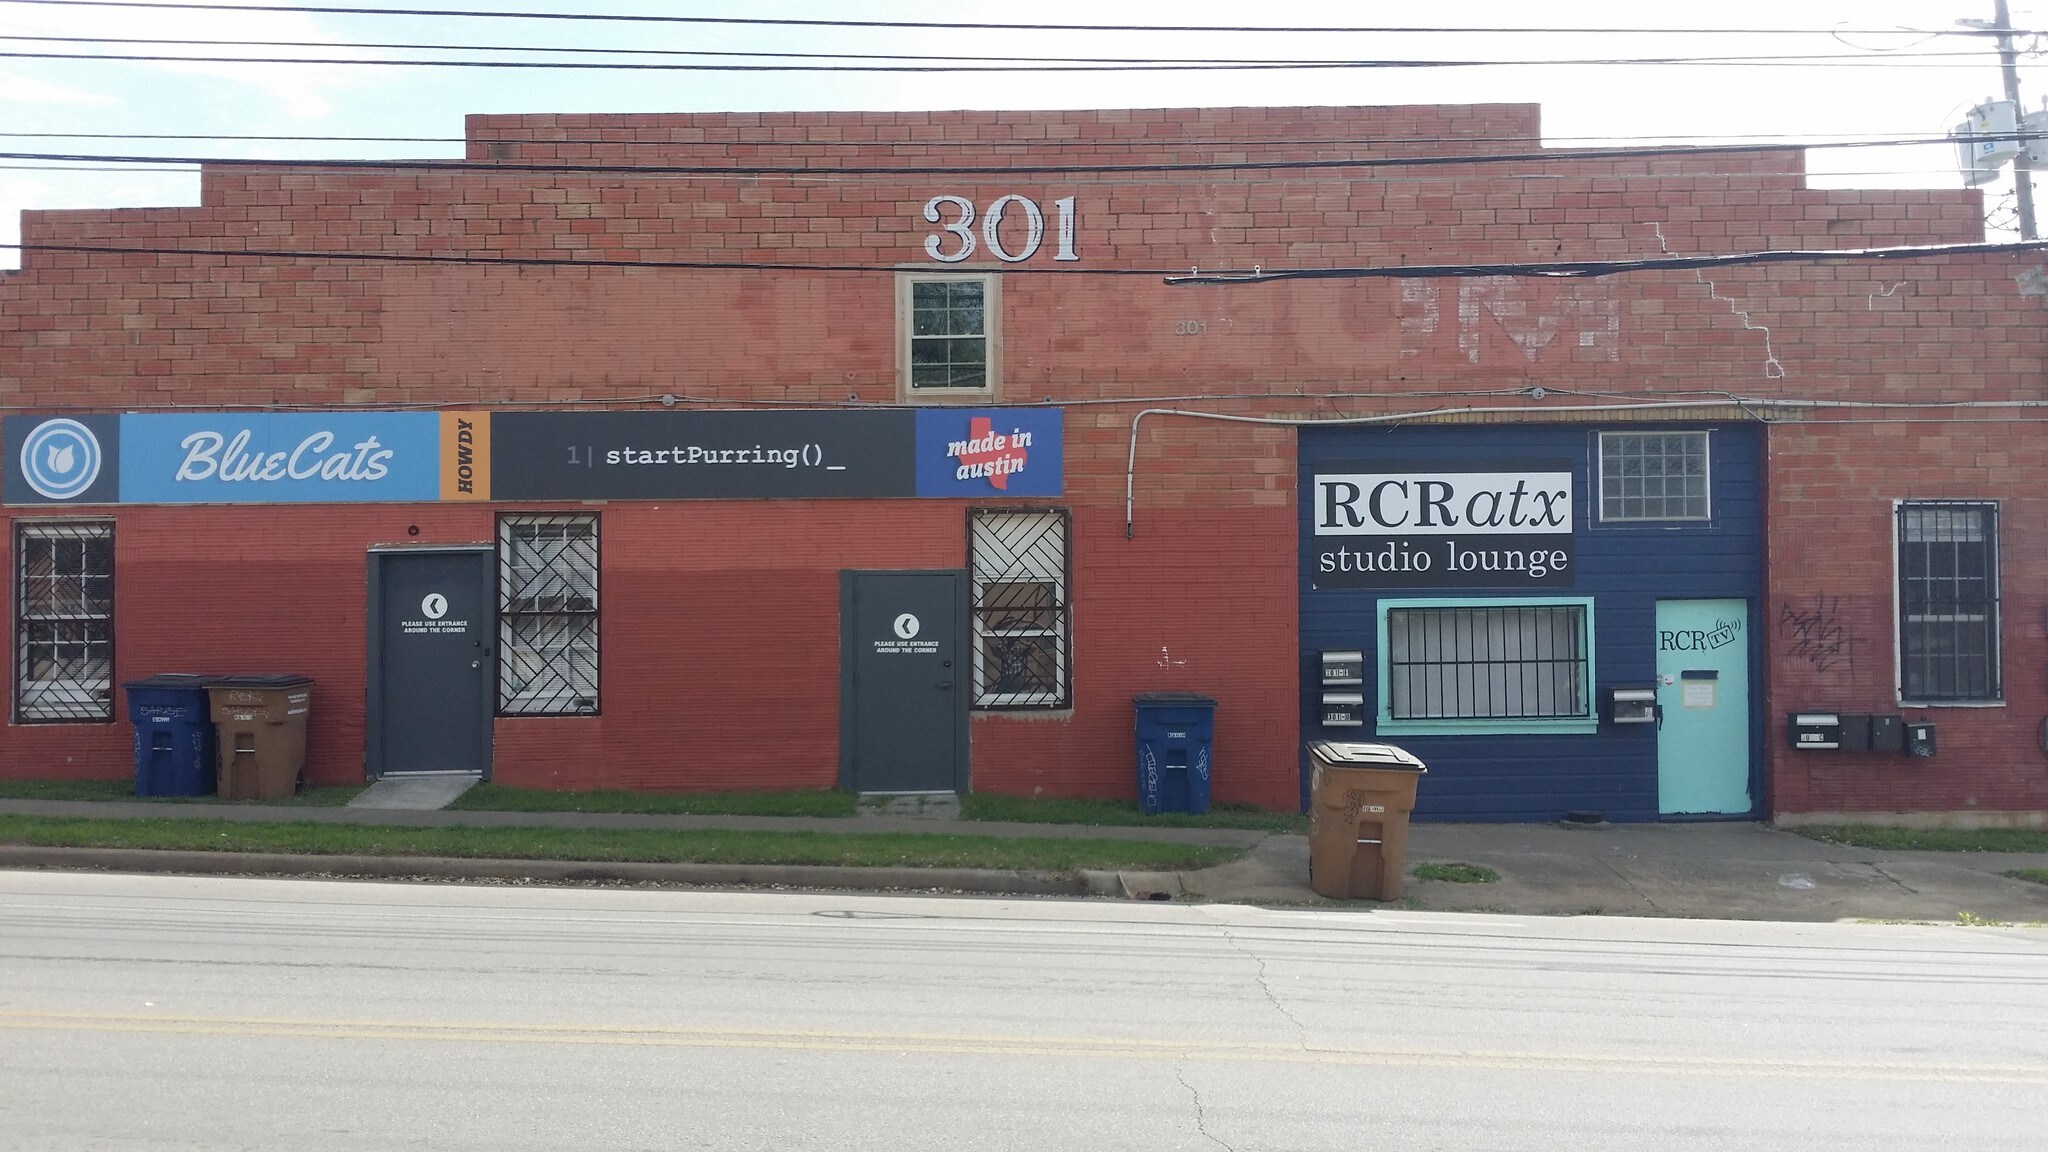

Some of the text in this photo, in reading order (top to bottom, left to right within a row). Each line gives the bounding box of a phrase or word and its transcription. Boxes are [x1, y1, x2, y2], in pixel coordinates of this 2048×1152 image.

[923, 194, 1081, 263] 301
[1174, 320, 1209, 336] 301
[174, 428, 395, 483] BlueCats
[457, 418, 475, 494] HOWDY
[946, 427, 1033, 457] made in
[956, 453, 1025, 481] austin
[1319, 479, 1568, 530] RCRatx
[1319, 541, 1569, 578] studio lounge
[1659, 629, 1729, 651] RCR TV
